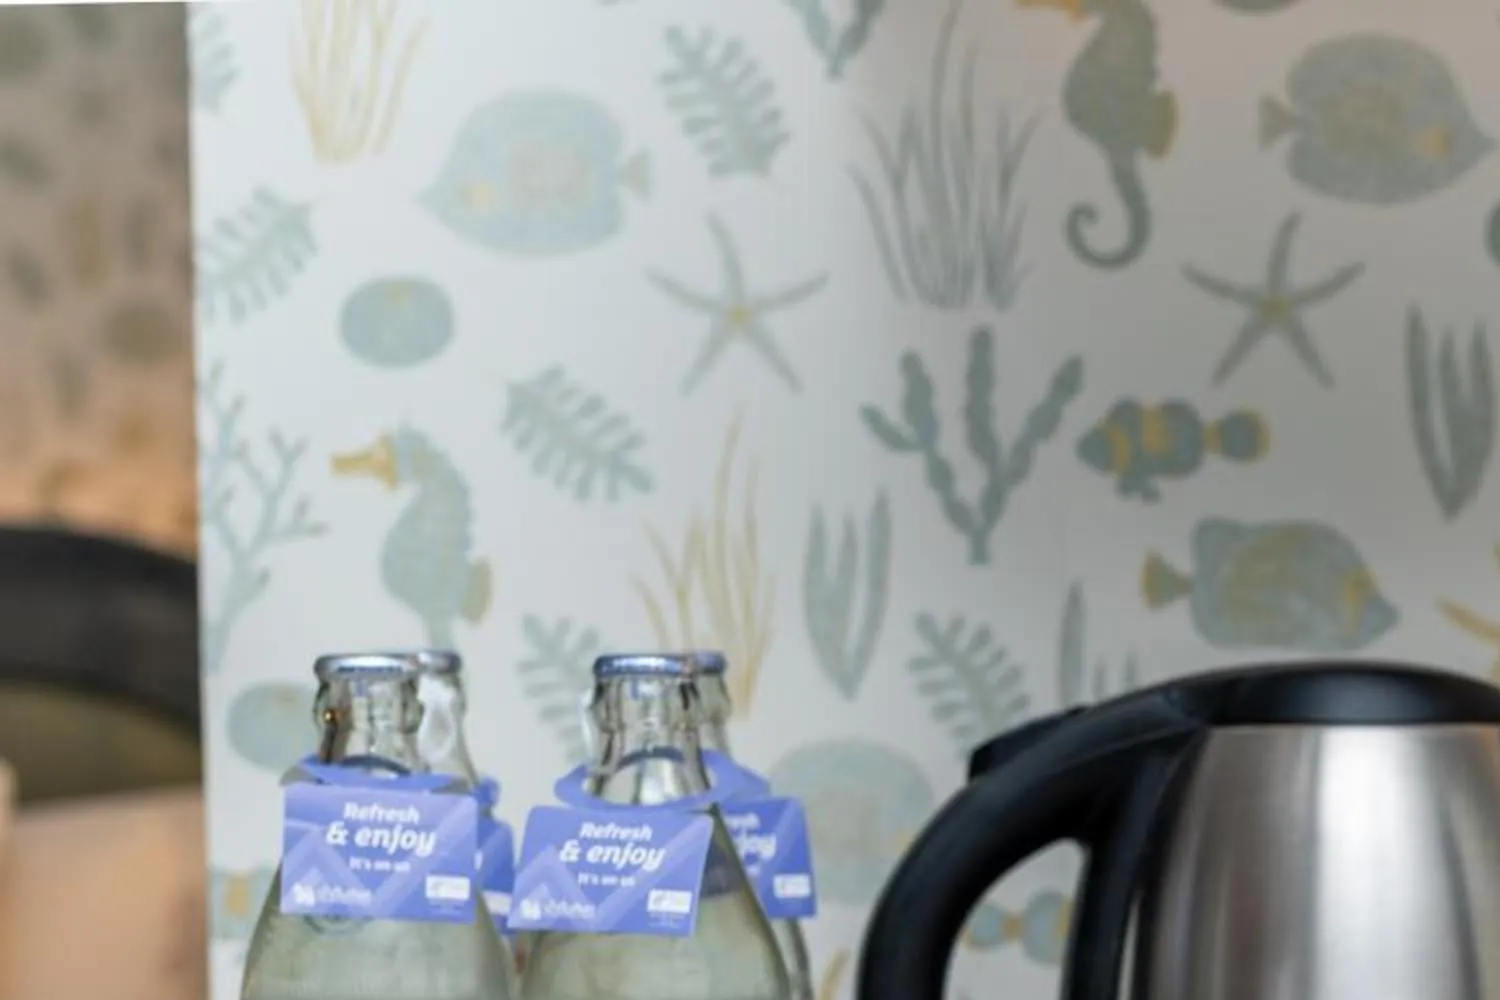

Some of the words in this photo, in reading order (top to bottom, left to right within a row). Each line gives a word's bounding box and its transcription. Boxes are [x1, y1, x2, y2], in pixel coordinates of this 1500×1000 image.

[343, 801, 420, 824] Refresh
[326, 821, 349, 846] &
[354, 824, 437, 858] enjoy
[580, 821, 653, 842] Refresh
[559, 839, 581, 863] &
[586, 842, 667, 872] enjoy
